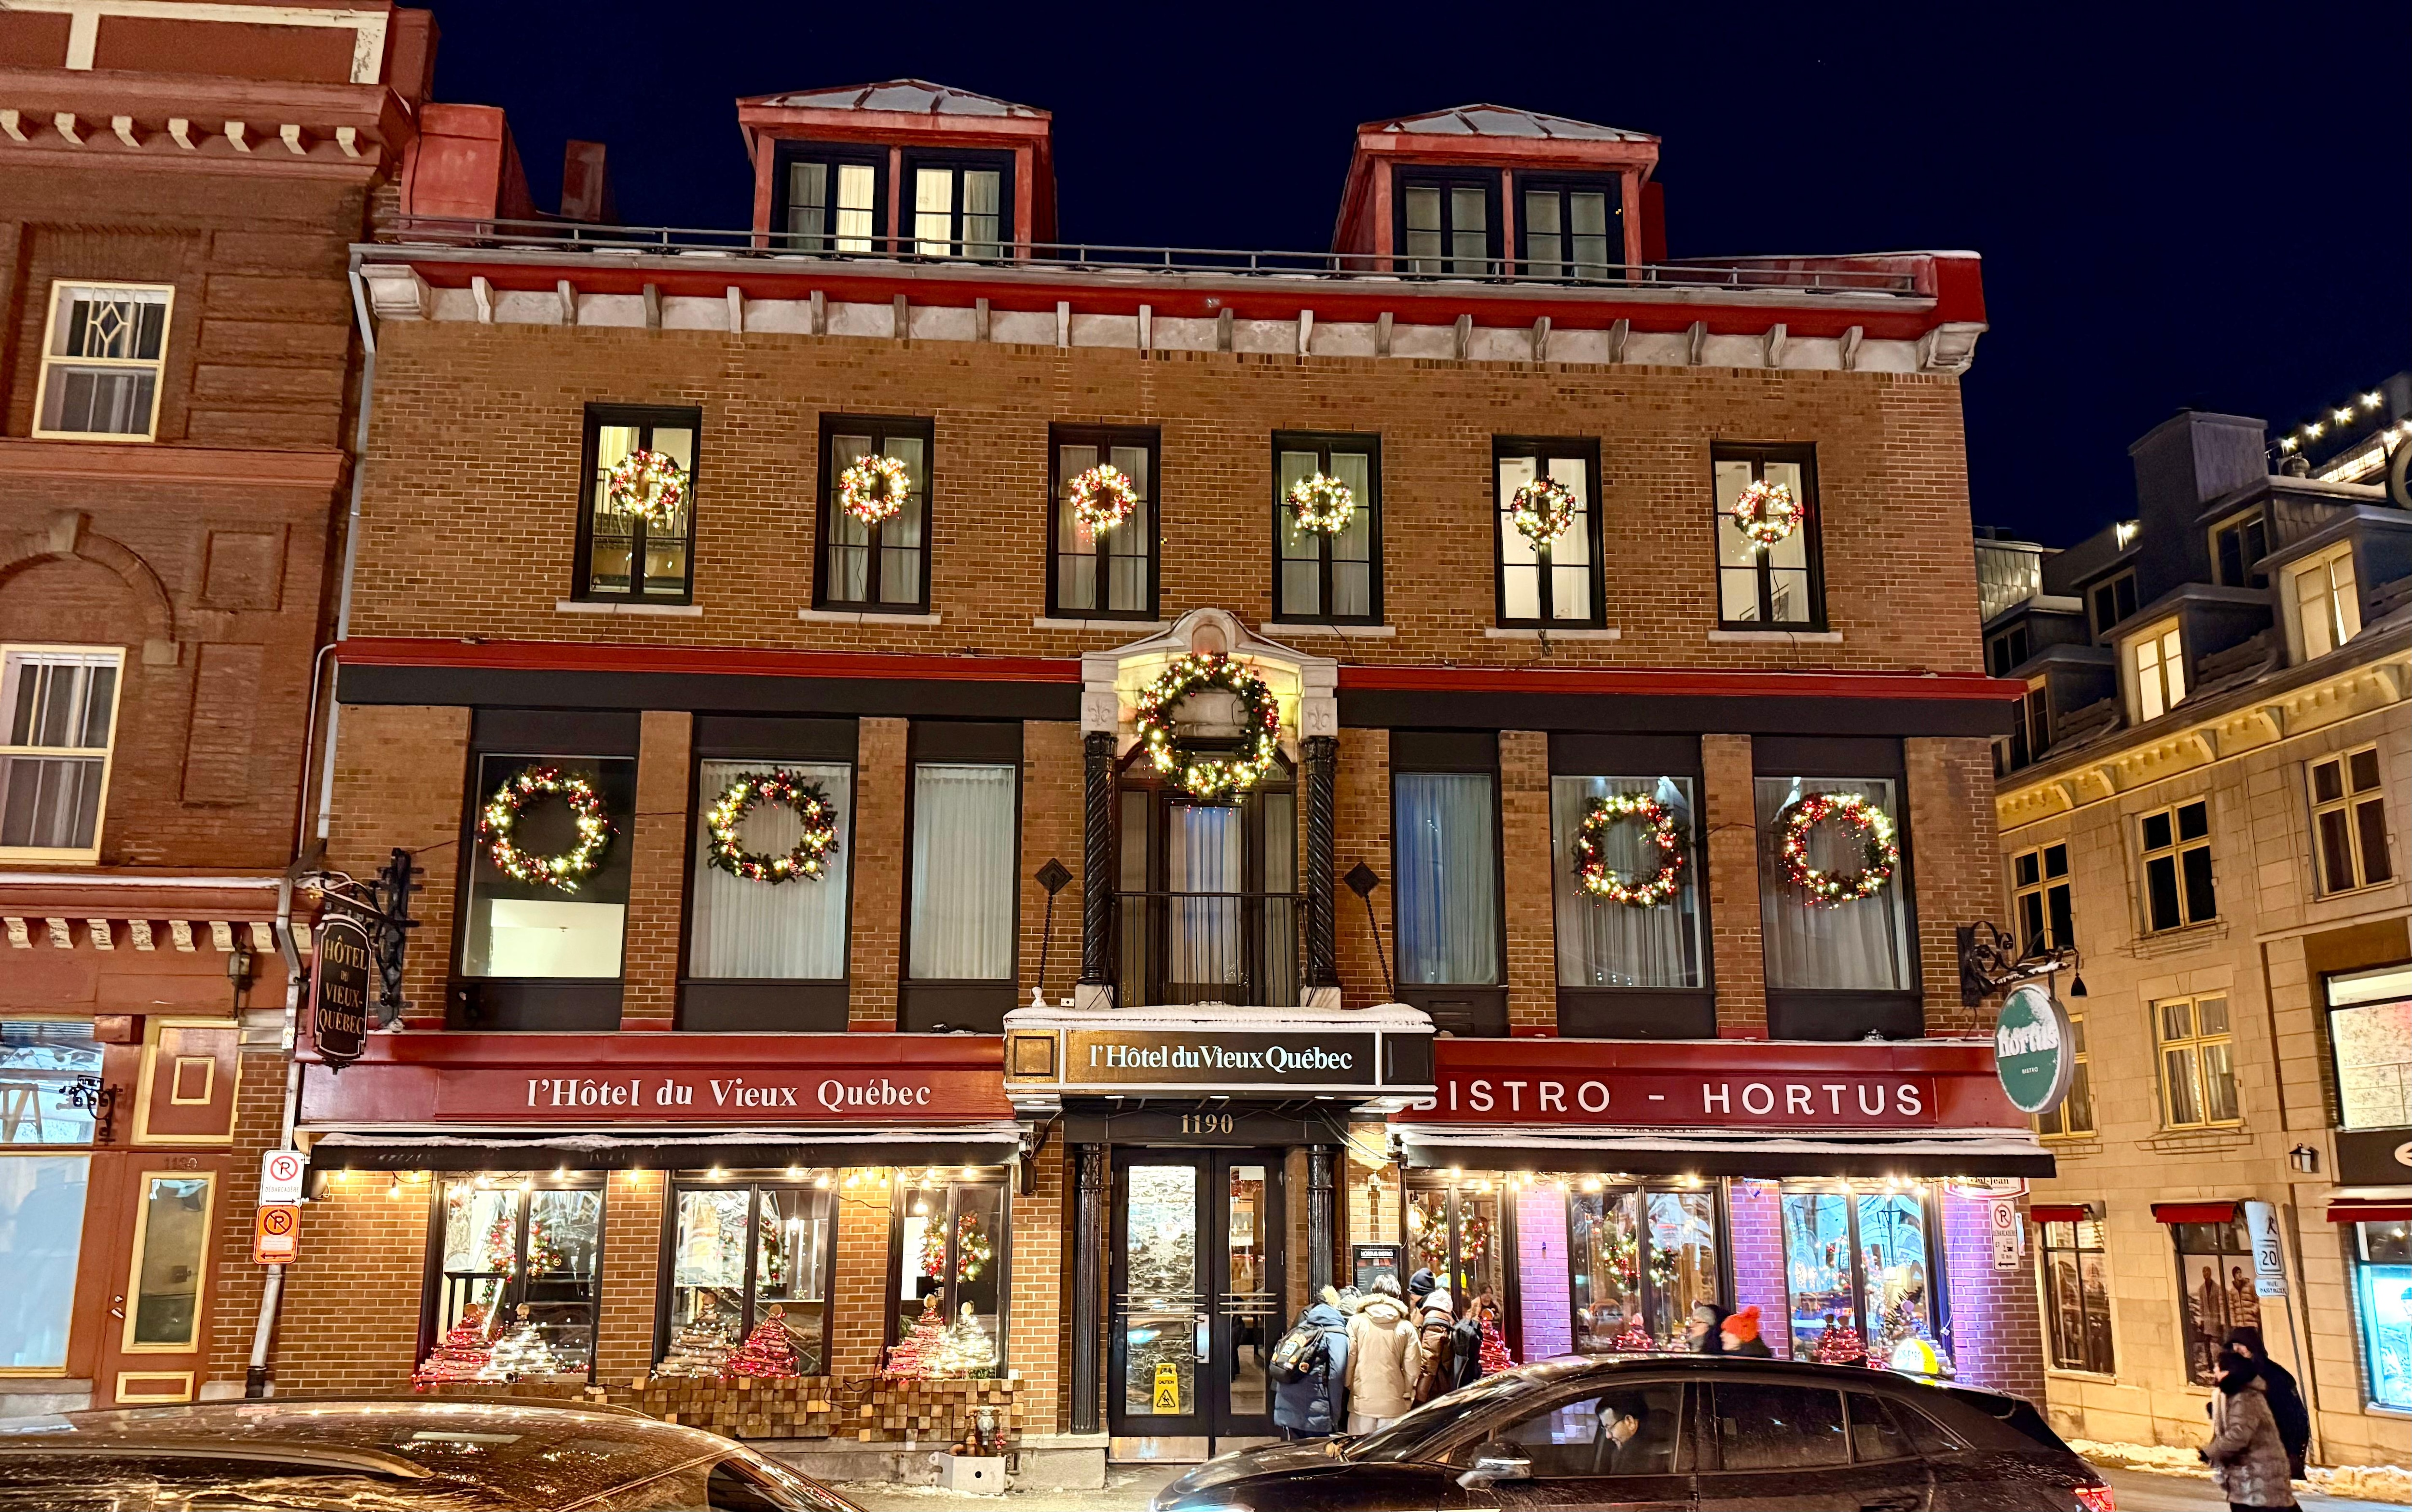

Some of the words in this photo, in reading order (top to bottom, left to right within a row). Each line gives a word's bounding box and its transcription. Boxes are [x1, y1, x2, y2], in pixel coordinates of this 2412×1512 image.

[324, 935, 367, 970] HÔTEL
[341, 970, 349, 982] DU
[325, 982, 363, 1008] VIEUX-
[319, 1007, 364, 1035] QUÉBEC
[1090, 1045, 1168, 1068] l'Hôtel
[1172, 1046, 1200, 1068] du
[1198, 1046, 1264, 1068] Vieux
[1265, 1046, 1353, 1073] Québec
[528, 1078, 642, 1106] l'Hôtel
[656, 1079, 693, 1106] du
[709, 1078, 798, 1107] Vieux
[818, 1078, 931, 1112] Québec
[1703, 1083, 1922, 1116] HORTUS
[1181, 1114, 1233, 1134] 1190
[2262, 1251, 2277, 1266] 20
